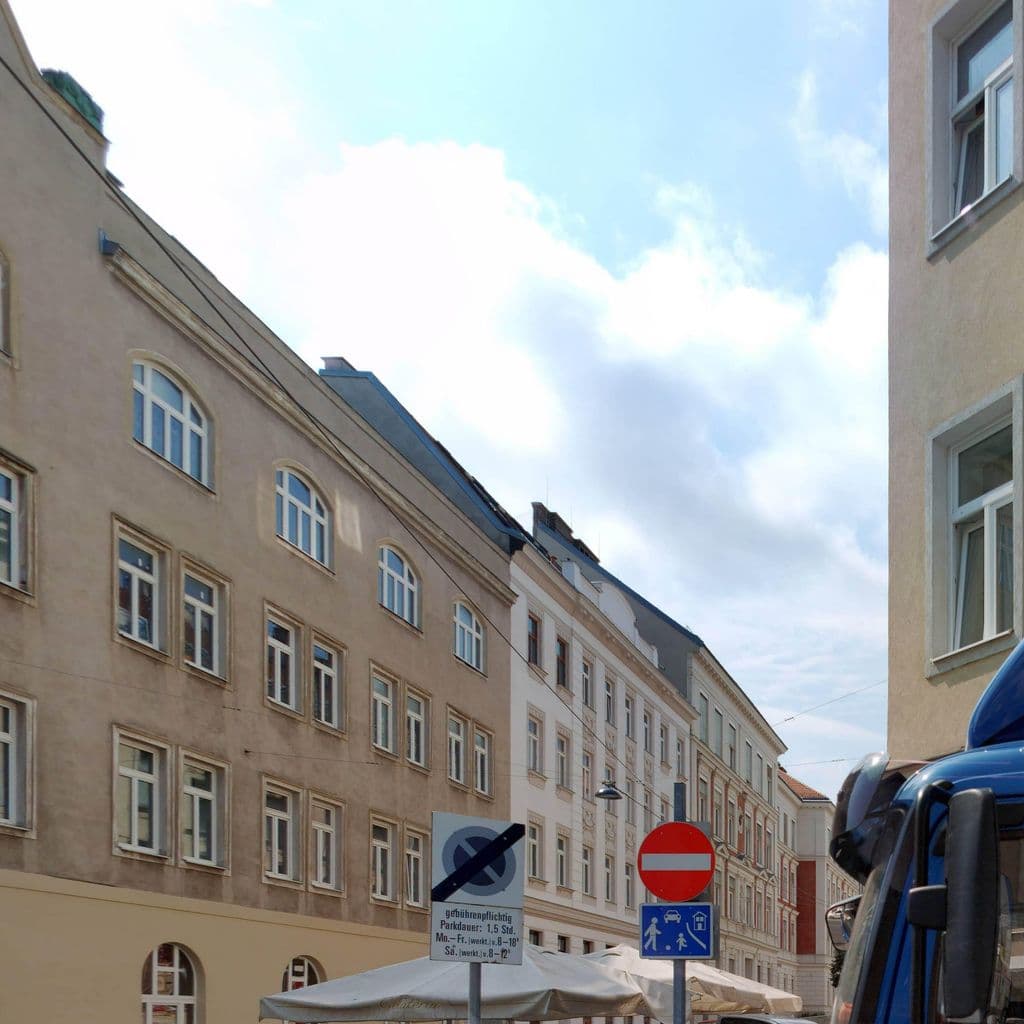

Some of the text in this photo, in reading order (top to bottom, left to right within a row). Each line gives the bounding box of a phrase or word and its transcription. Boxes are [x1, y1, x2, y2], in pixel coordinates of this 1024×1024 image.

[445, 909, 513, 925] gebührenpflichtig
[440, 920, 483, 932] Parkdauer:
[501, 925, 516, 935] Std.
